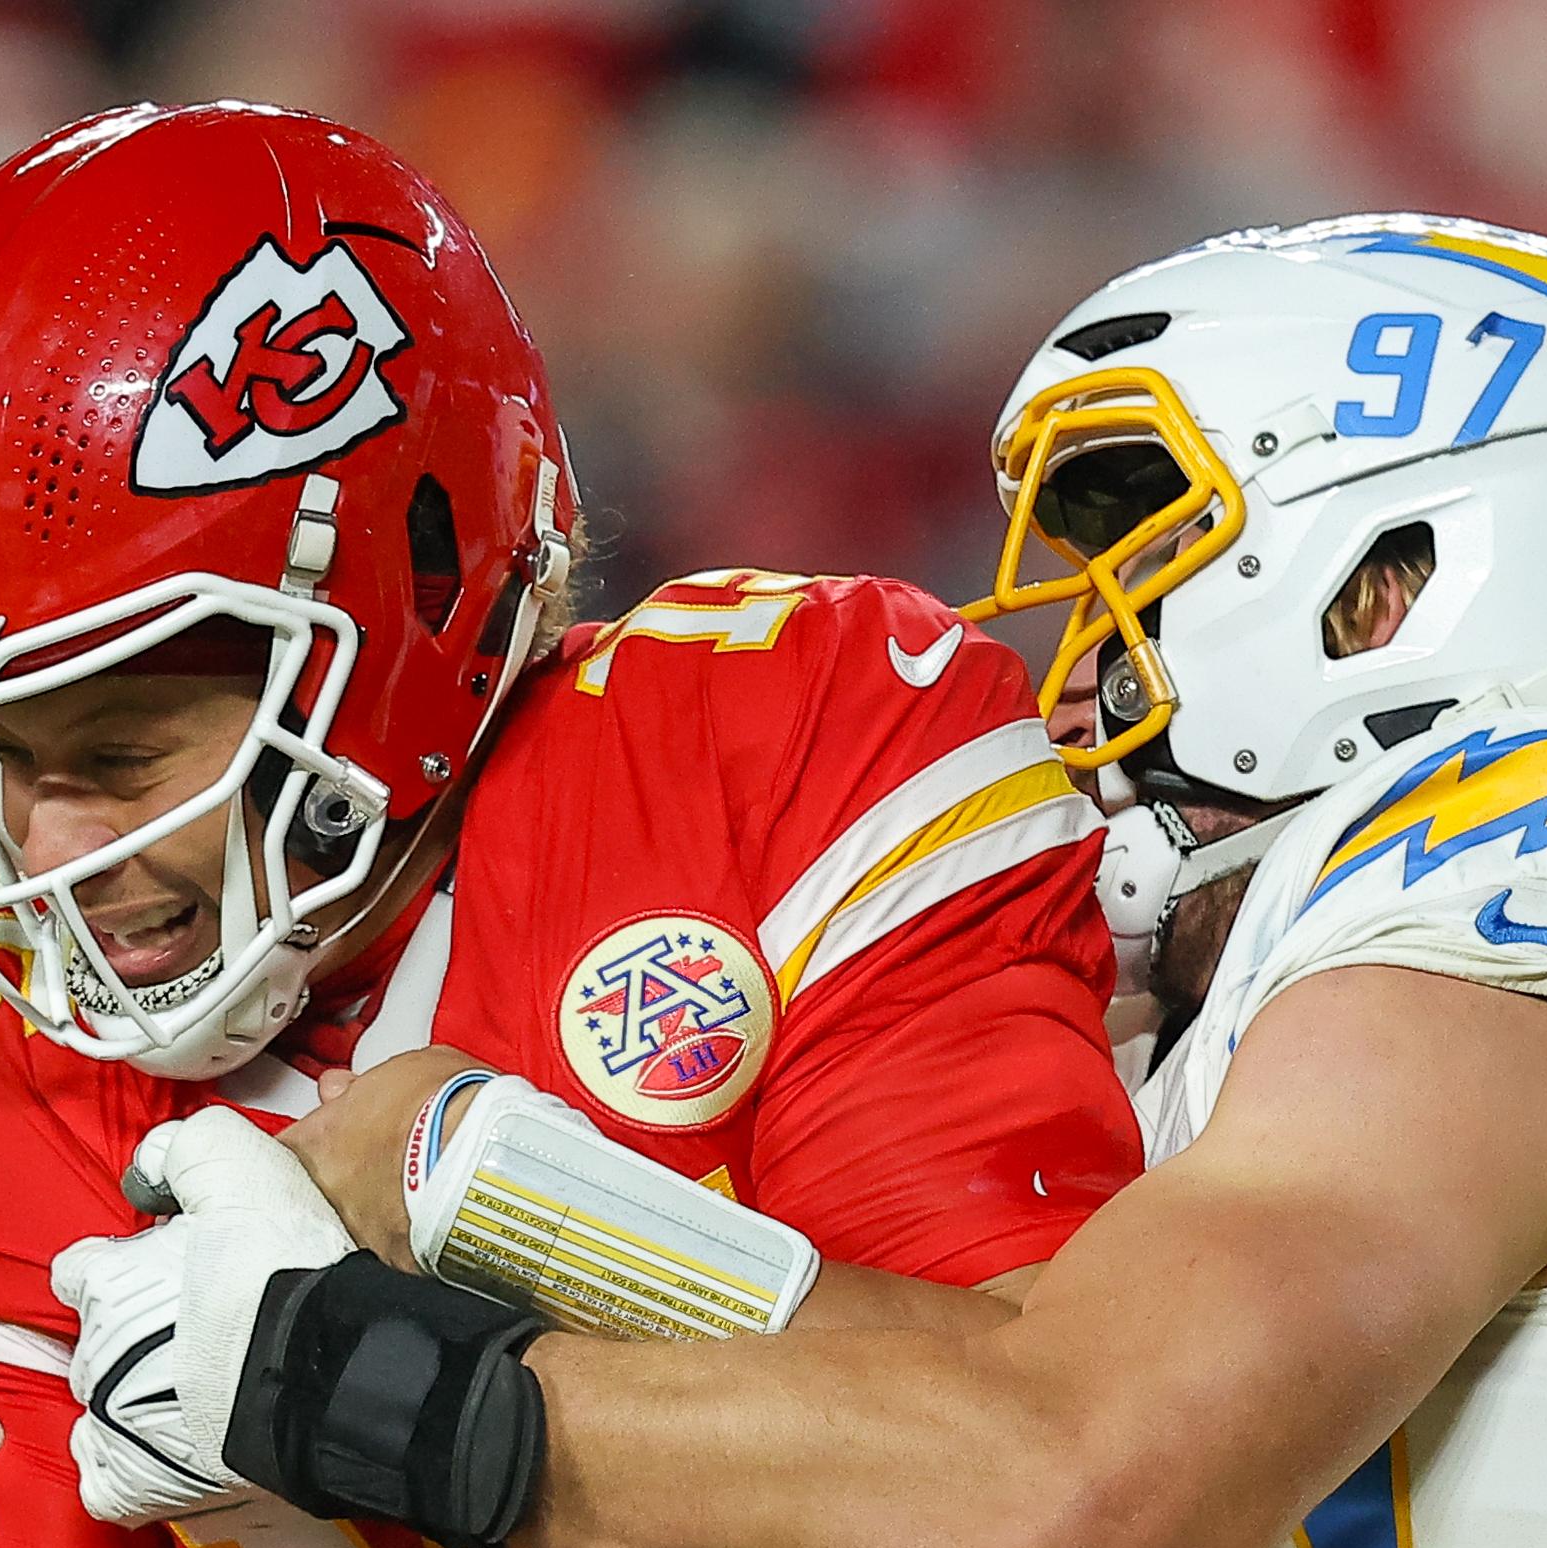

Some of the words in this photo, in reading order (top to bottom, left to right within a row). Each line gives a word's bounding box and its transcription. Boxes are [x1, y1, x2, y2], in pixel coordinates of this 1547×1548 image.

[165, 290, 376, 462] KC
[1333, 310, 1547, 447] 97
[575, 567, 856, 697] 1
[668, 1043, 721, 1083] LH
[407, 1093, 436, 1192] COURA
